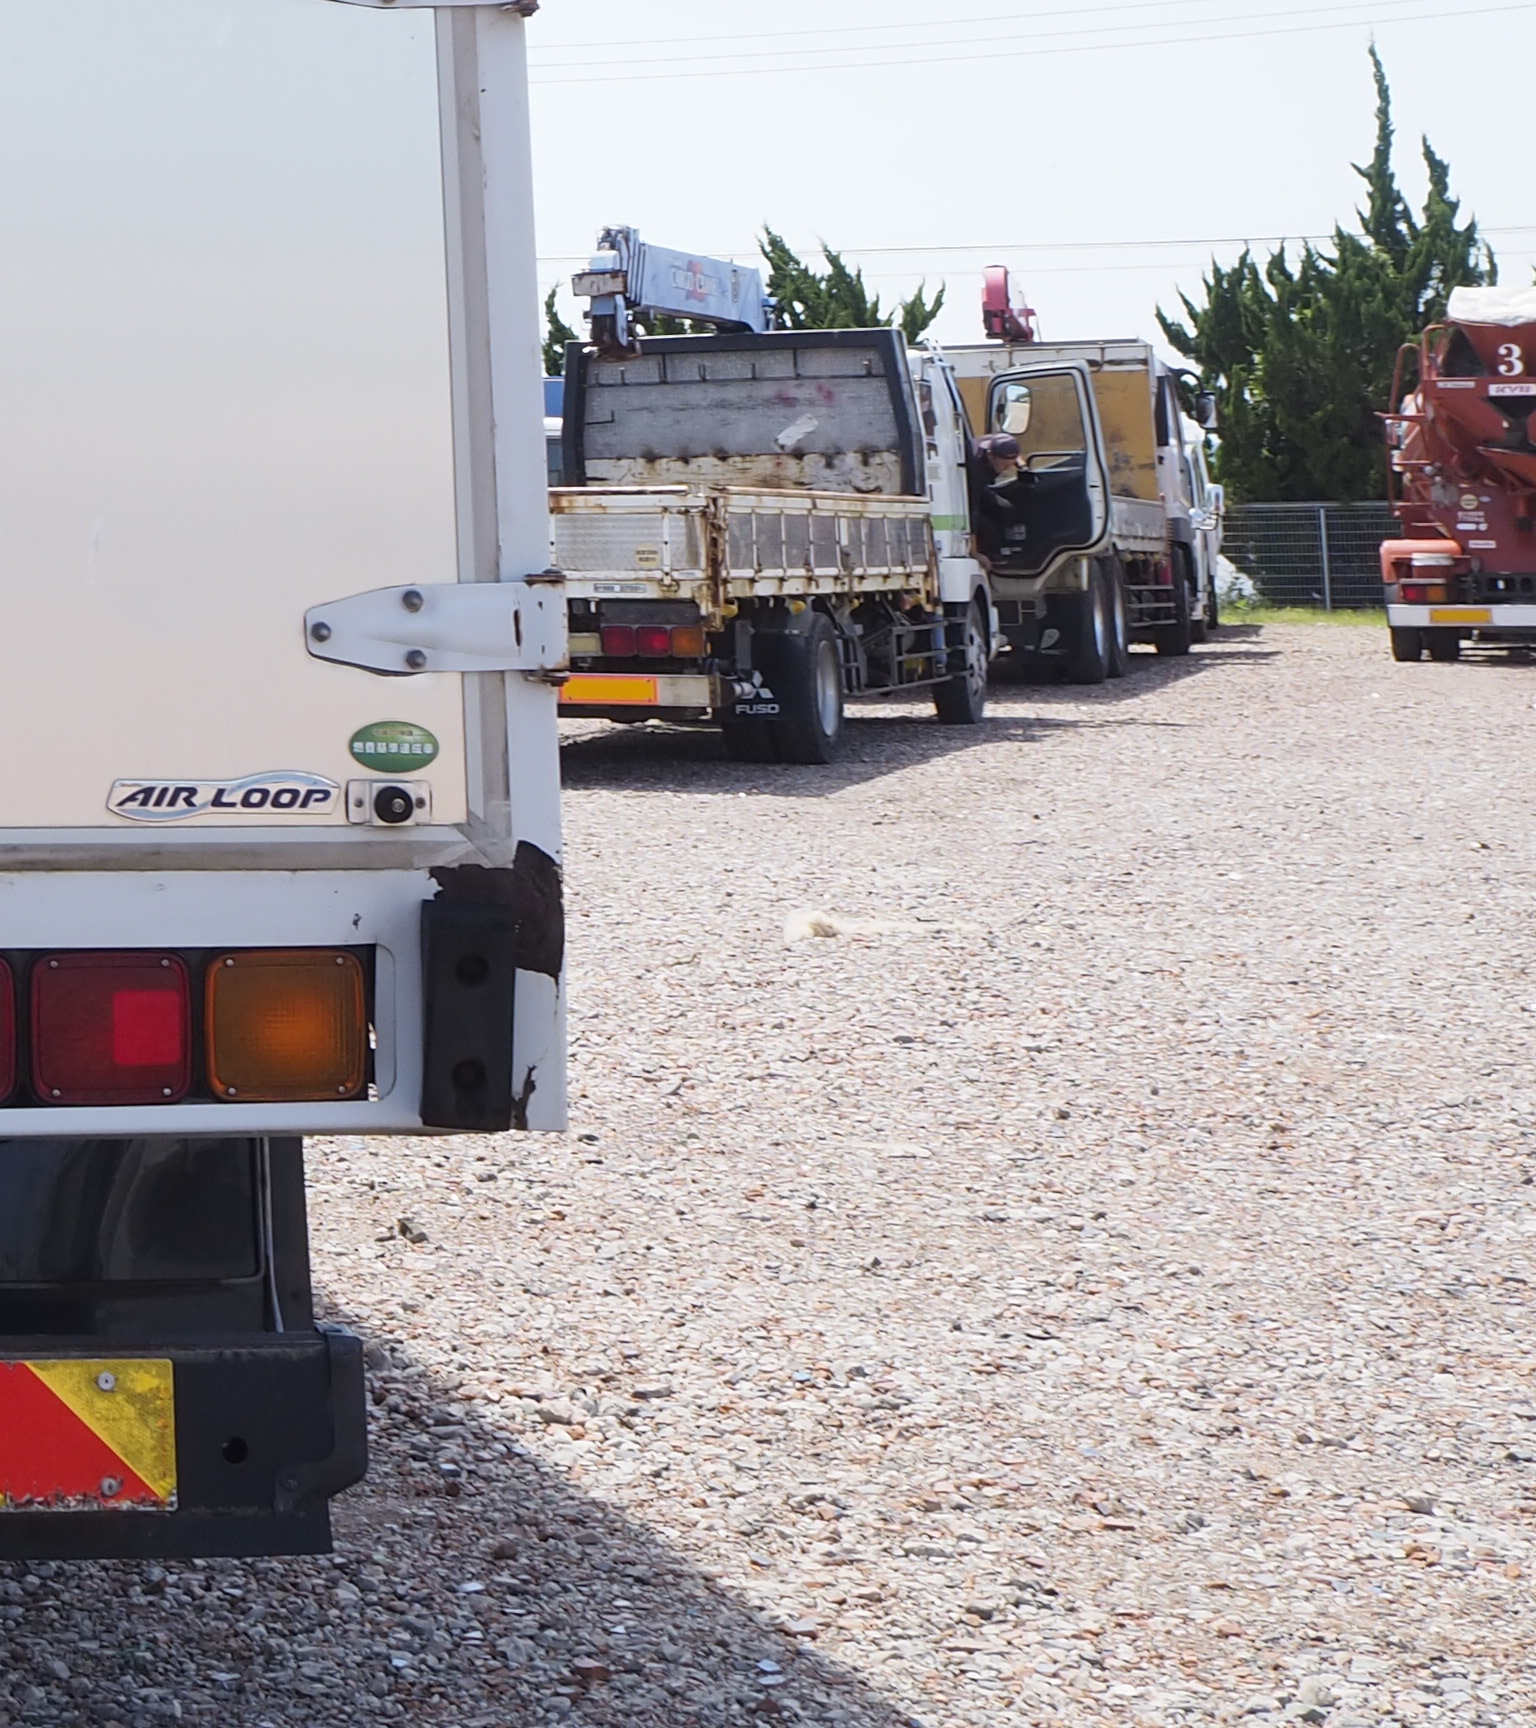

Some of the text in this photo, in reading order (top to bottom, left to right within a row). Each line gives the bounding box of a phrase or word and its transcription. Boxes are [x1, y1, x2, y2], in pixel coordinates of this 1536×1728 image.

[1497, 343, 1524, 376] 3
[735, 703, 779, 714] FUSO
[115, 786, 332, 809] AIR LOOP
